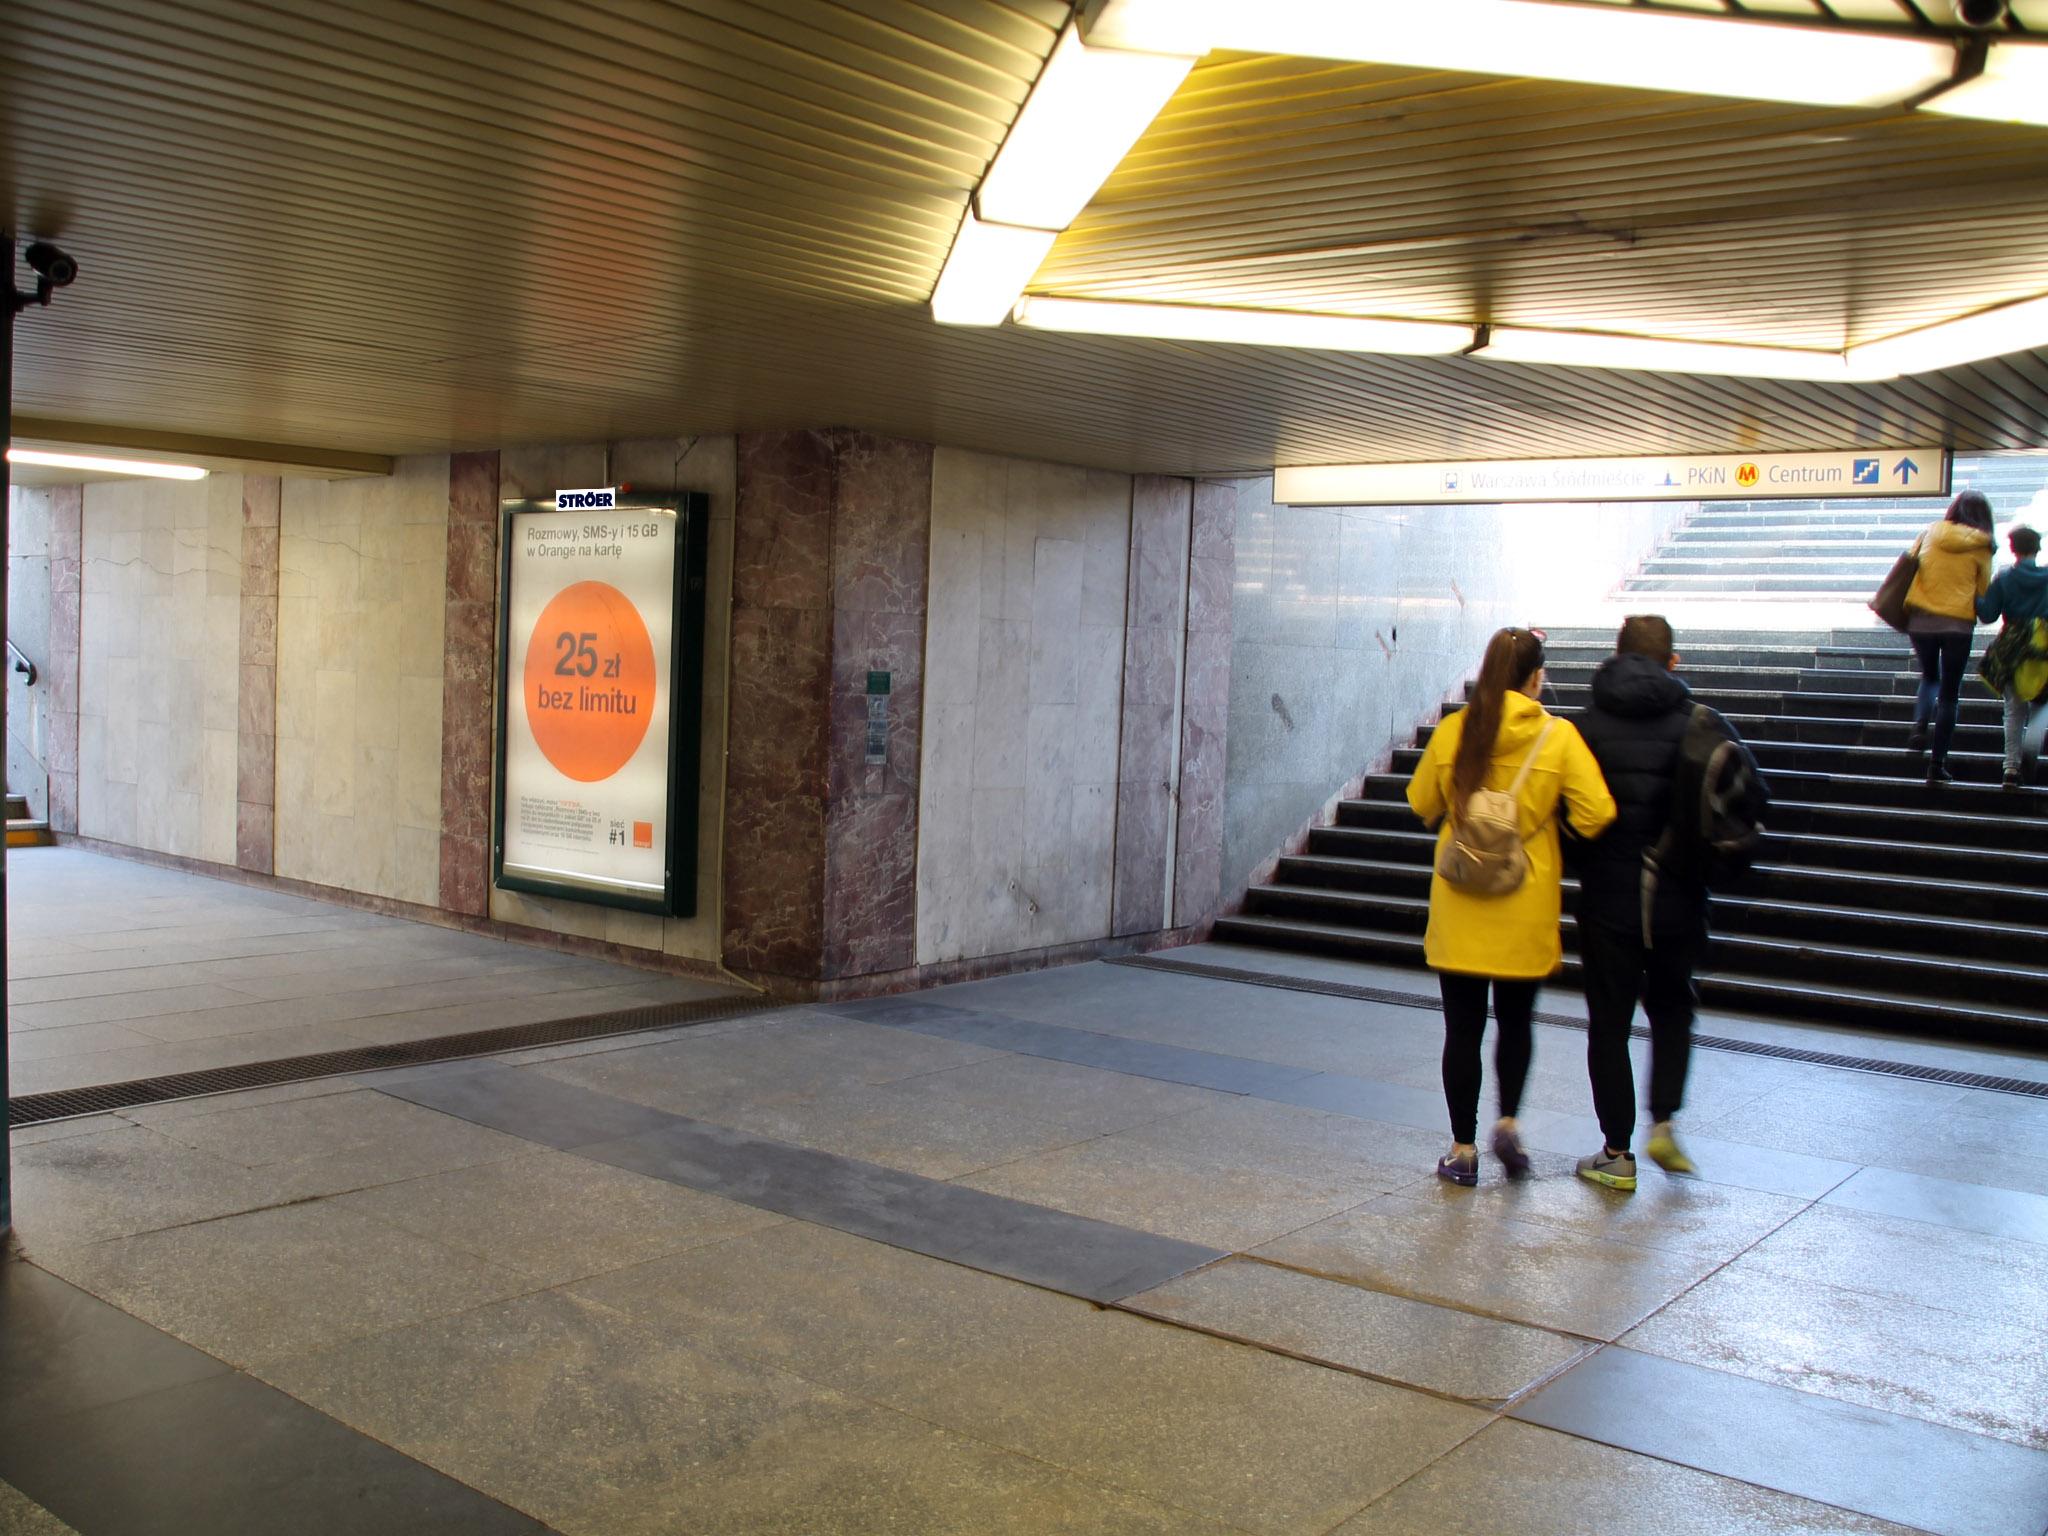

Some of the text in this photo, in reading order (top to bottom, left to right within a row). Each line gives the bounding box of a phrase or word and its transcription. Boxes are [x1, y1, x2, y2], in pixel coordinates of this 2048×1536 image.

[1471, 471, 1547, 489] Warszawa
[1688, 465, 1726, 485] PKiN
[1768, 464, 1842, 484] Centrum
[558, 491, 613, 508] STRÖER
[527, 523, 659, 542] Rozmowy, SMS-y i 15 GB
[527, 543, 622, 560] w Orange na kartę
[554, 631, 621, 678] 25 zł
[538, 684, 637, 714] bez limitu
[609, 828, 625, 846] #1
